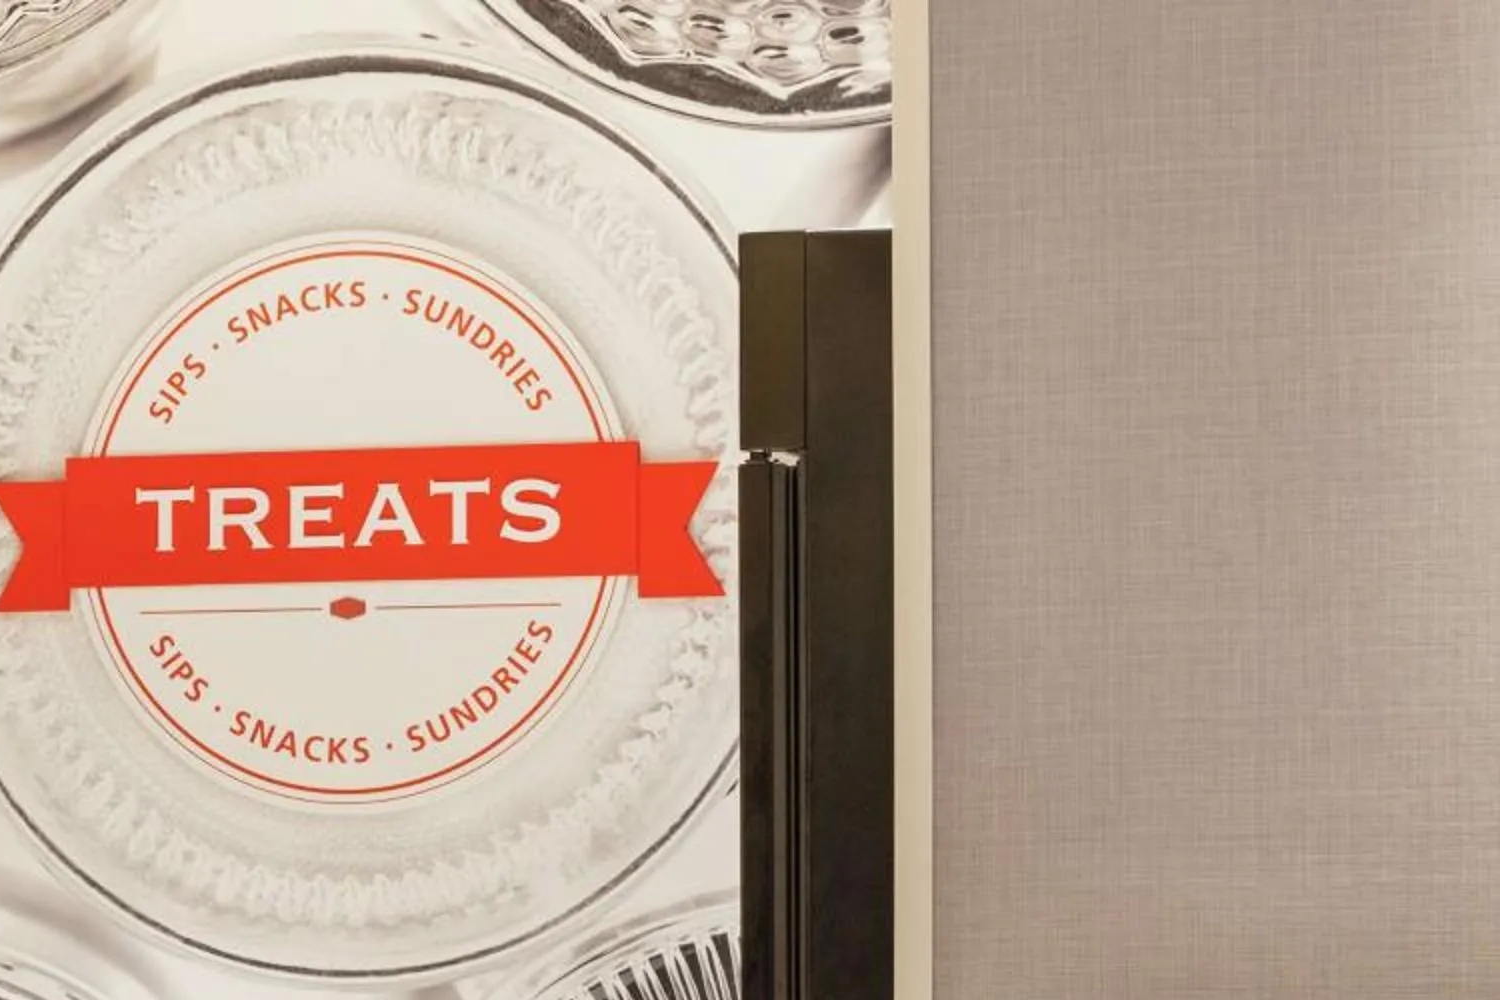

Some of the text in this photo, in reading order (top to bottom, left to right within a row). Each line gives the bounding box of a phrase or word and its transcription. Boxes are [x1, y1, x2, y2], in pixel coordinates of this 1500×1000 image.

[148, 280, 553, 424] SIPS SNACKS SUNDRIES
[134, 477, 562, 553] TREATS
[148, 619, 554, 765] SIPS SNACKS SUNDRIES
